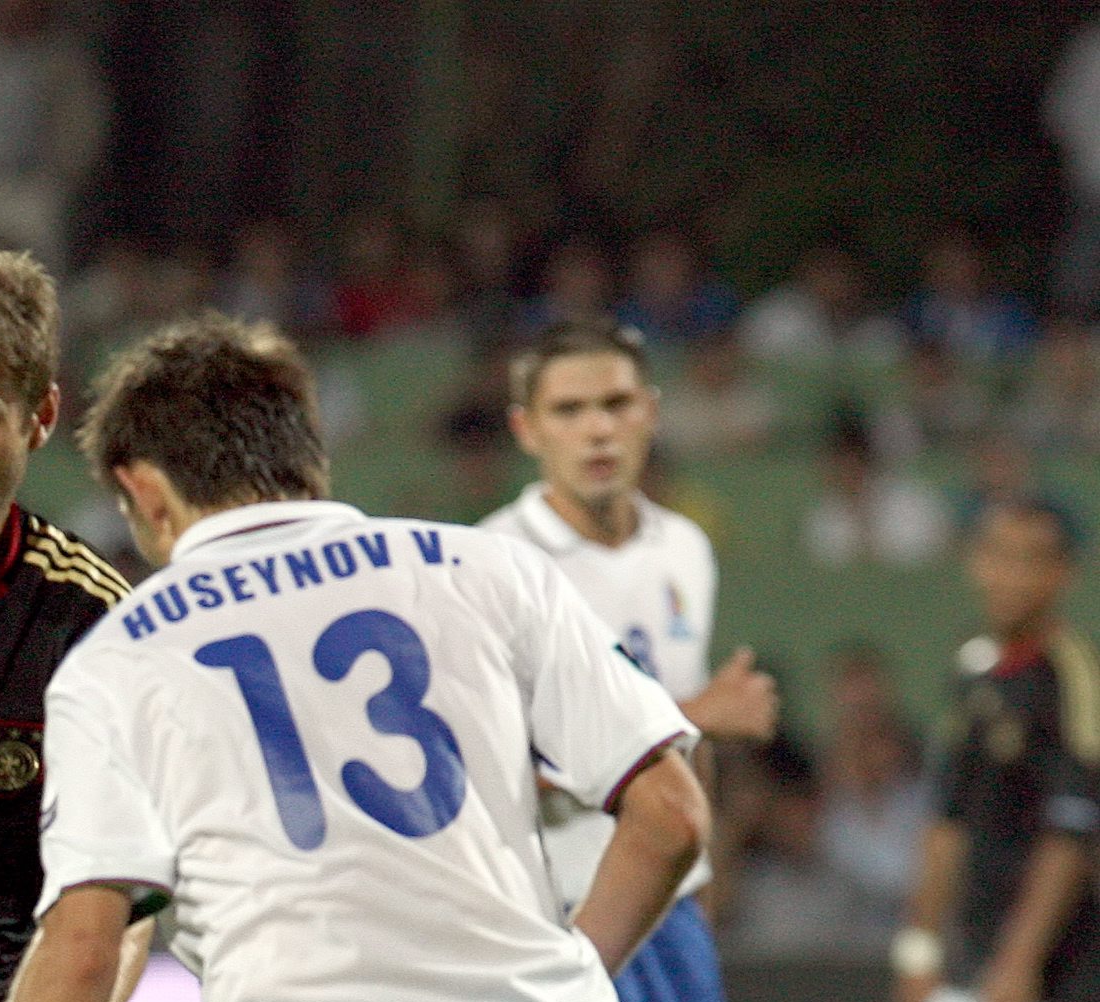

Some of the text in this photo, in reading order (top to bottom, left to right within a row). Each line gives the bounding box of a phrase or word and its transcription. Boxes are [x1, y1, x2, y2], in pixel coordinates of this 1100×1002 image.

[122, 530, 462, 641] HUSEYNOV V.
[193, 608, 467, 852] 13
